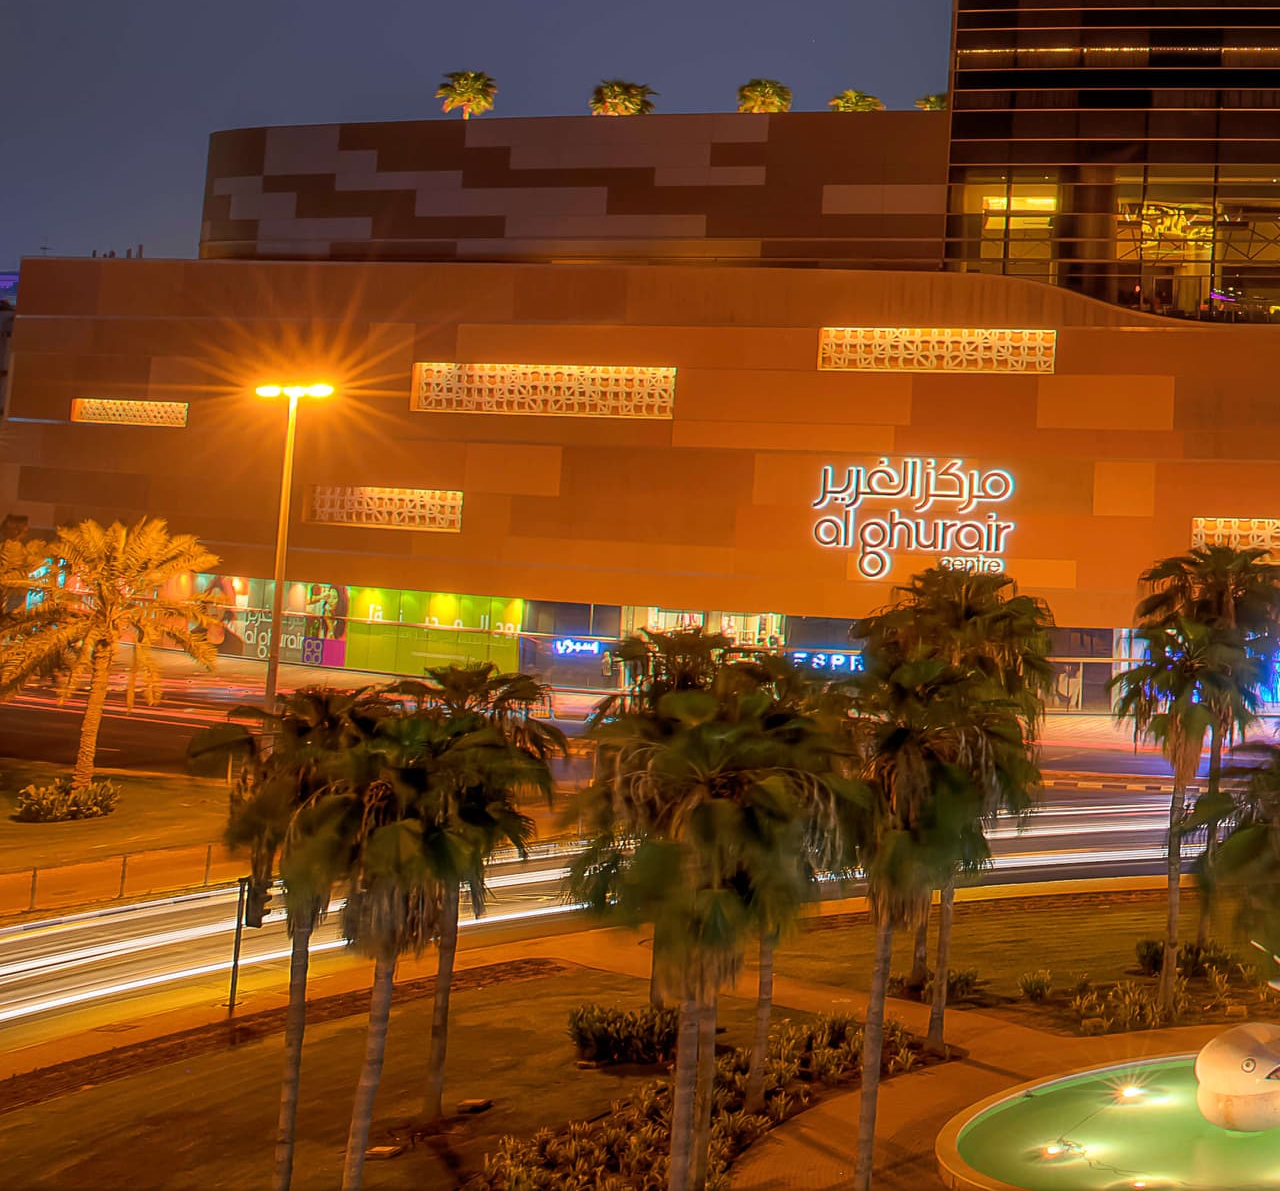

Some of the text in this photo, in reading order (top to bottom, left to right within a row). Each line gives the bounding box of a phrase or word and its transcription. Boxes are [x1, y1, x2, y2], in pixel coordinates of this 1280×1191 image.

[812, 457, 1015, 514] مركز الغرير
[813, 508, 1015, 579] al ghurair
[245, 626, 257, 644] al
